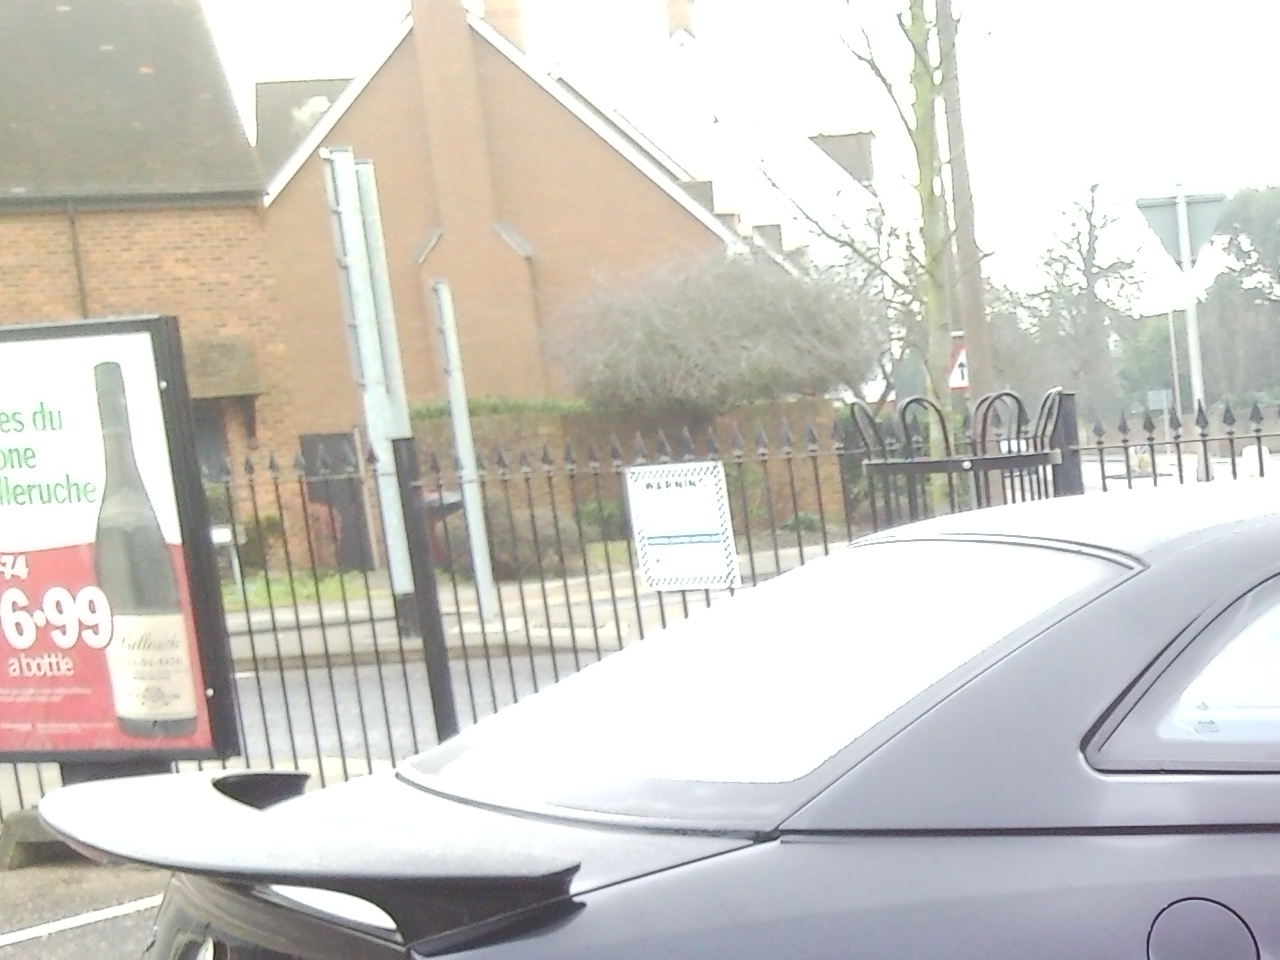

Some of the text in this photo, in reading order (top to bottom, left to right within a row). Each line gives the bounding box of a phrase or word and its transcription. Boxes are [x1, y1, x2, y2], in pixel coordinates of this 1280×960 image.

[32, 401, 63, 431] du
[8, 652, 75, 678] a bottle
